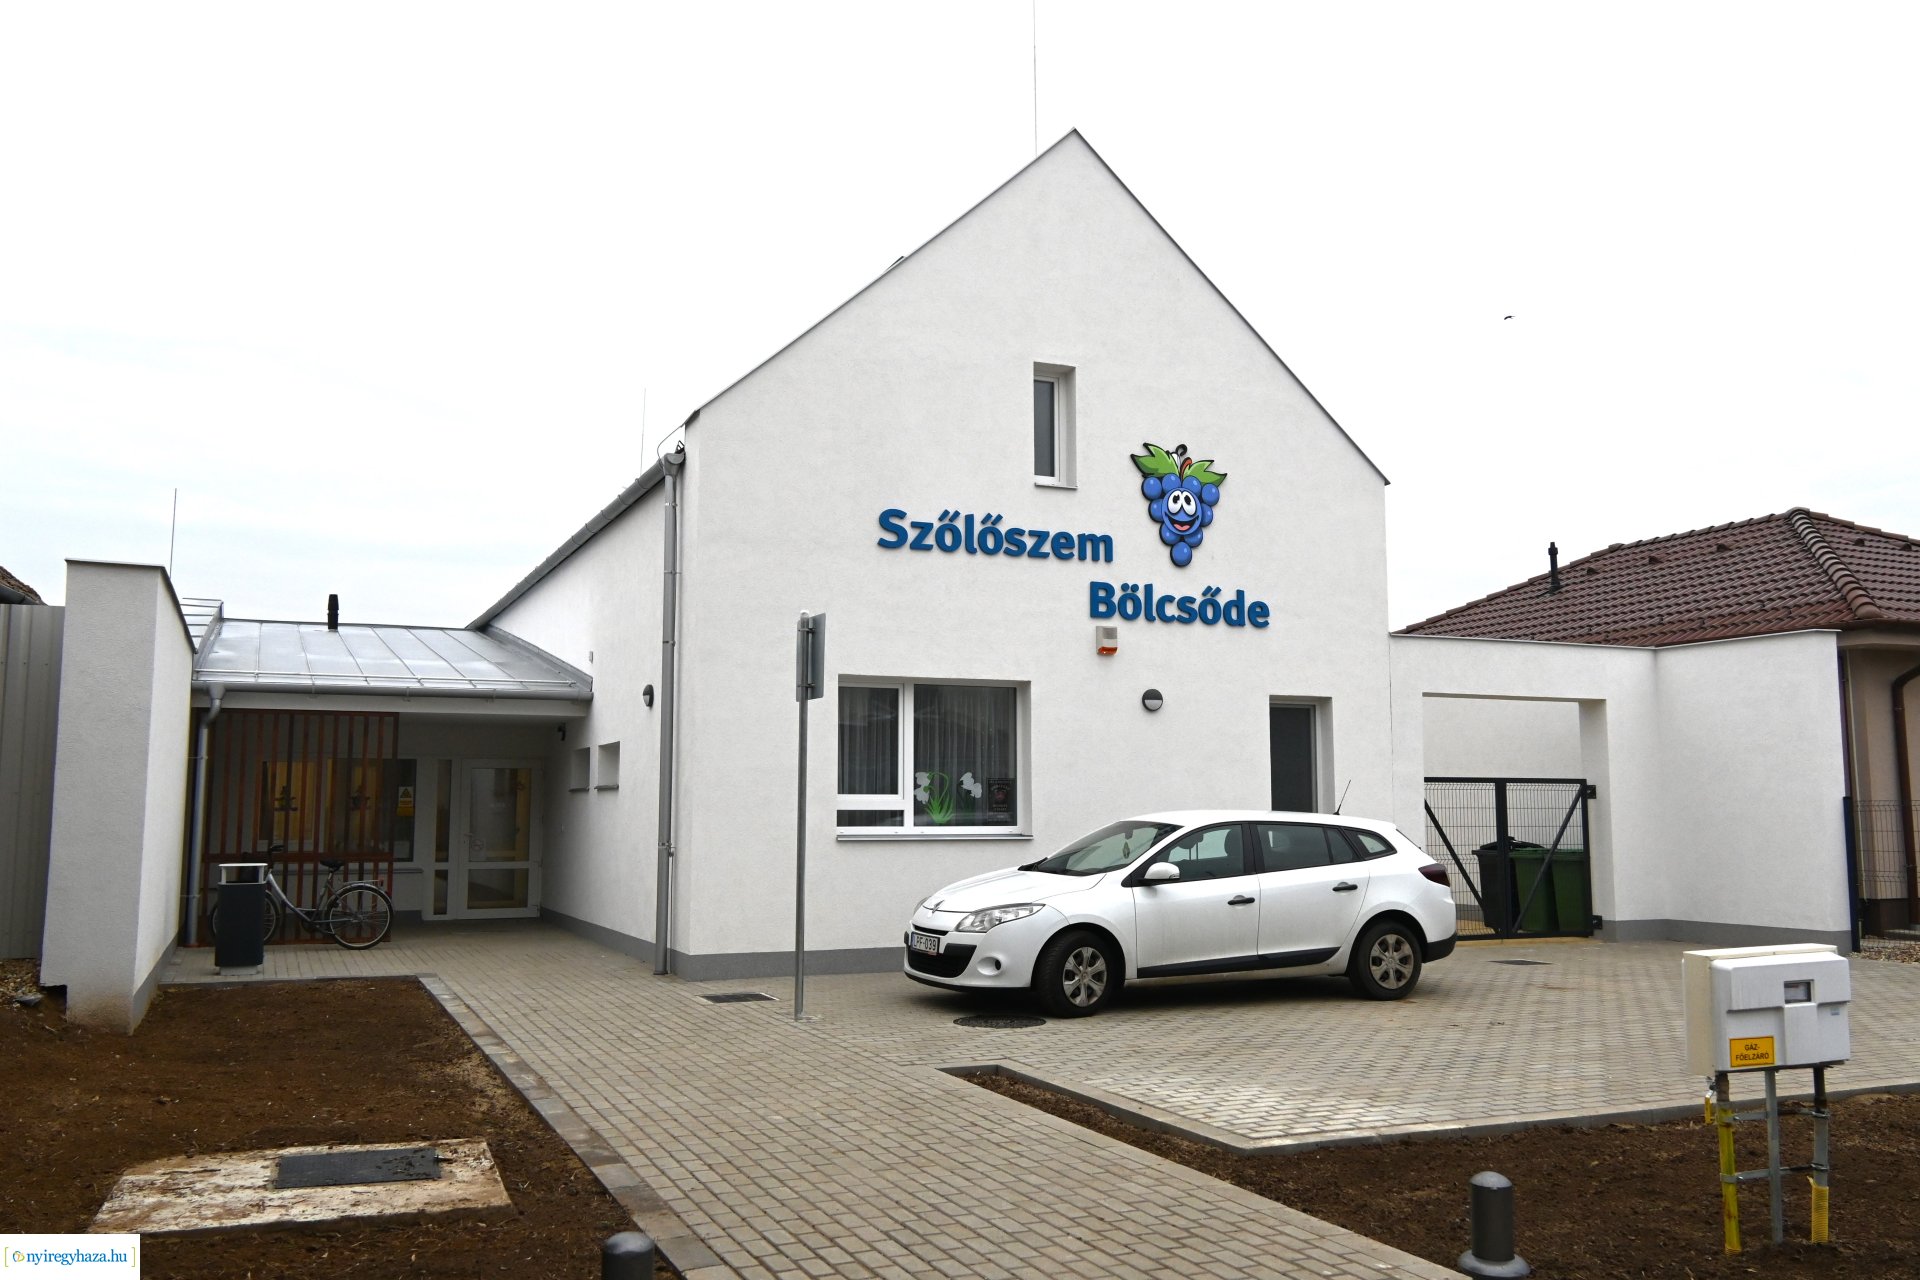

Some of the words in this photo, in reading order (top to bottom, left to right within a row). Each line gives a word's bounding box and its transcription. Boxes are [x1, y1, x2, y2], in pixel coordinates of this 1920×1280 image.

[877, 508, 1114, 563] Szőlőszem
[1089, 581, 1270, 629] Bölcsőde
[1736, 1052, 1769, 1061] FŐELZÁRÓ
[1745, 1043, 1760, 1051] GÁZ-
